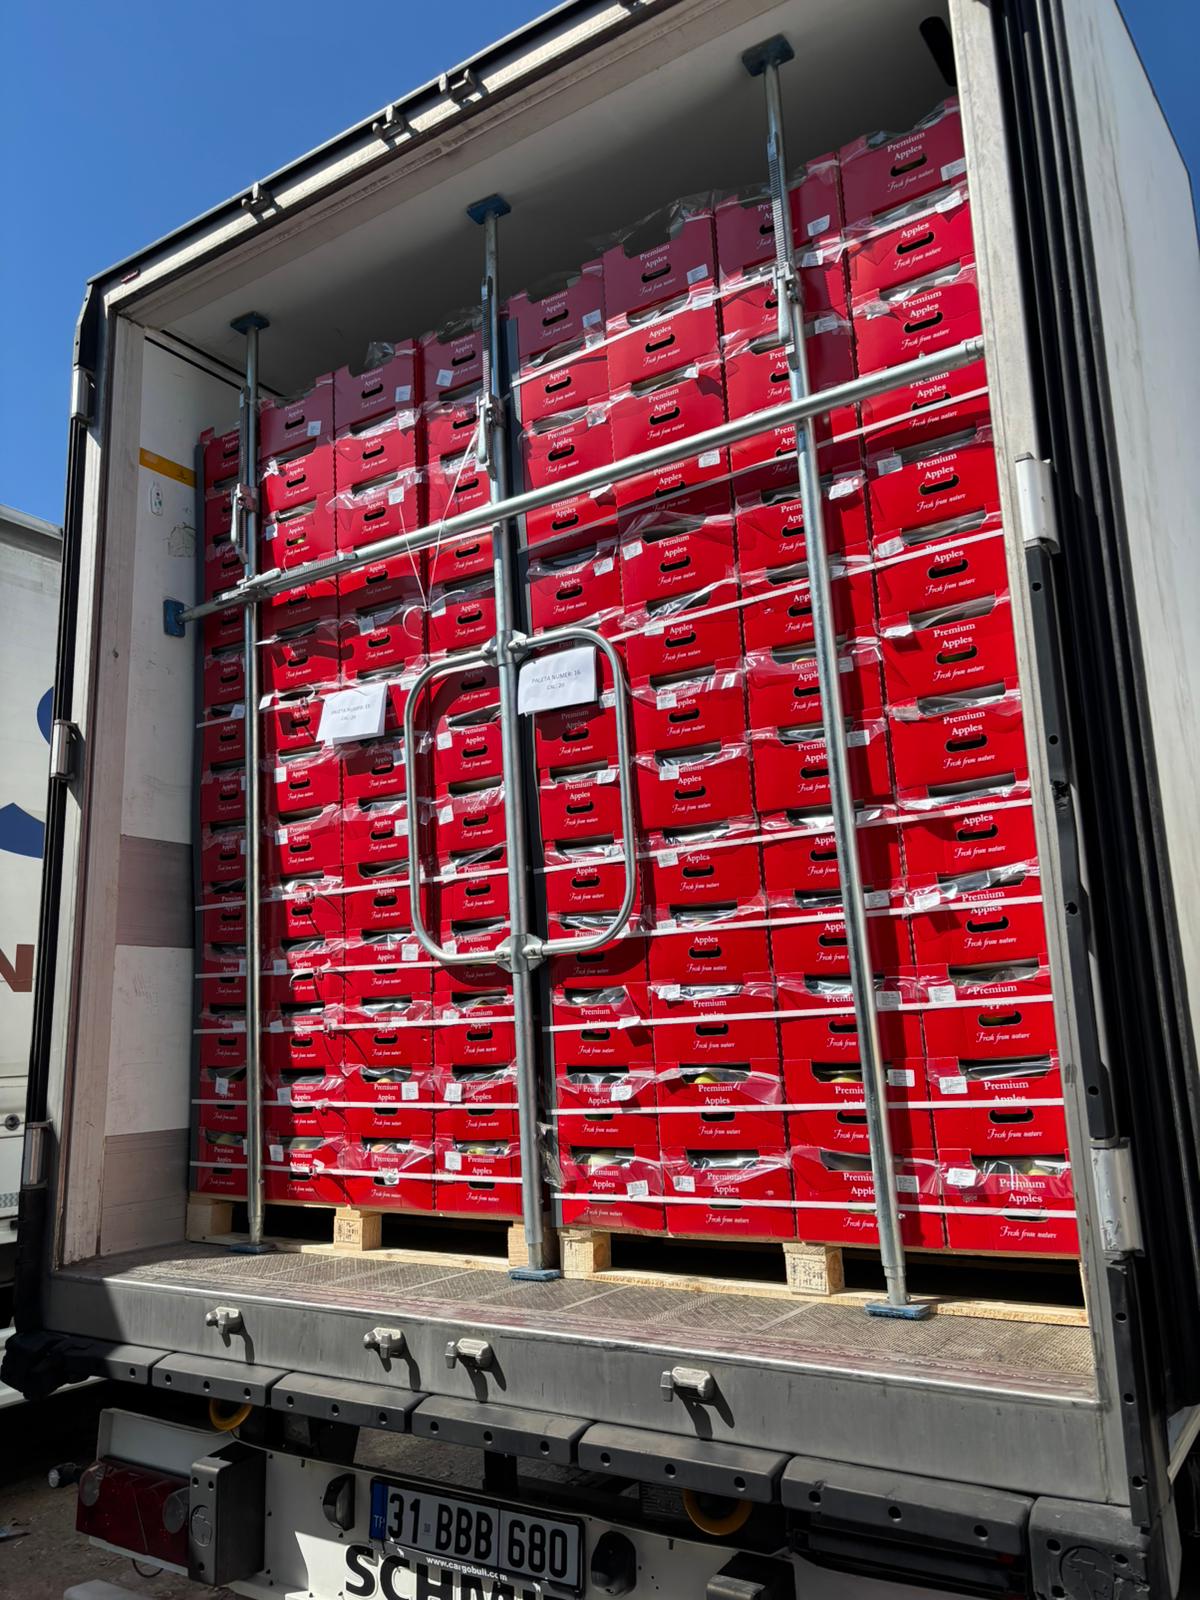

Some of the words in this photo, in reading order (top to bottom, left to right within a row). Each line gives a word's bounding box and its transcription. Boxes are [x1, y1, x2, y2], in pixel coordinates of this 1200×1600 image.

[887, 133, 925, 153] Premium
[895, 145, 922, 160] Apples
[902, 223, 929, 238] Apples
[639, 245, 669, 261] Premium
[645, 256, 667, 268] Apples
[902, 289, 941, 308] Premium
[910, 304, 939, 318] Apples
[649, 326, 671, 338] Apples
[647, 387, 679, 403] Premium
[917, 384, 946, 398] Apples
[654, 400, 676, 412] Apples
[366, 438, 381, 447] Apples
[552, 438, 572, 448] Apples
[916, 454, 957, 470] Premium
[289, 468, 304, 476] Apples
[652, 461, 685, 476] Premium
[925, 467, 954, 480] Apples
[659, 474, 682, 485] Apples
[657, 534, 689, 548] Premium
[664, 547, 687, 558] Apples
[934, 551, 964, 563] Apples
[560, 578, 580, 588] Apples
[461, 603, 480, 612] Apples
[670, 624, 692, 634] Apples
[932, 624, 975, 638] Premium
[942, 637, 972, 650] Apples
[797, 670, 820, 682] Apple
[943, 712, 985, 724] Premium
[952, 724, 983, 736] Apples
[466, 736, 485, 745] Apples
[805, 752, 829, 763] Apple
[291, 769, 308, 778] Apples
[563, 780, 594, 790] Premium
[677, 774, 701, 785] Apples
[570, 792, 590, 800] Apples
[374, 820, 391, 828] Apples
[963, 814, 993, 826] Apples
[292, 833, 309, 842] Apples
[686, 853, 710, 863] Apples
[575, 867, 597, 876] Apples
[964, 890, 1004, 900] Premium
[694, 936, 718, 945] Apples
[377, 954, 395, 962] Apples
[972, 982, 1018, 994] Premium
[692, 999, 726, 1007] Premium
[697, 1084, 734, 1092] Premium
[984, 1081, 1029, 1090] Premium
[588, 1097, 611, 1105] Apples
[704, 1097, 730, 1105] Apples
[471, 1167, 492, 1175] Apples
[708, 1172, 743, 1181] Premium
[593, 1180, 615, 1189] Apples
[1000, 1177, 1045, 1190] Premium
[713, 1185, 739, 1194] Apples
[851, 1186, 876, 1196] Apple
[1009, 1192, 1042, 1205] Apples
[388, 1493, 421, 1544] 31
[435, 1503, 494, 1561] BBB
[507, 1519, 568, 1578] 680
